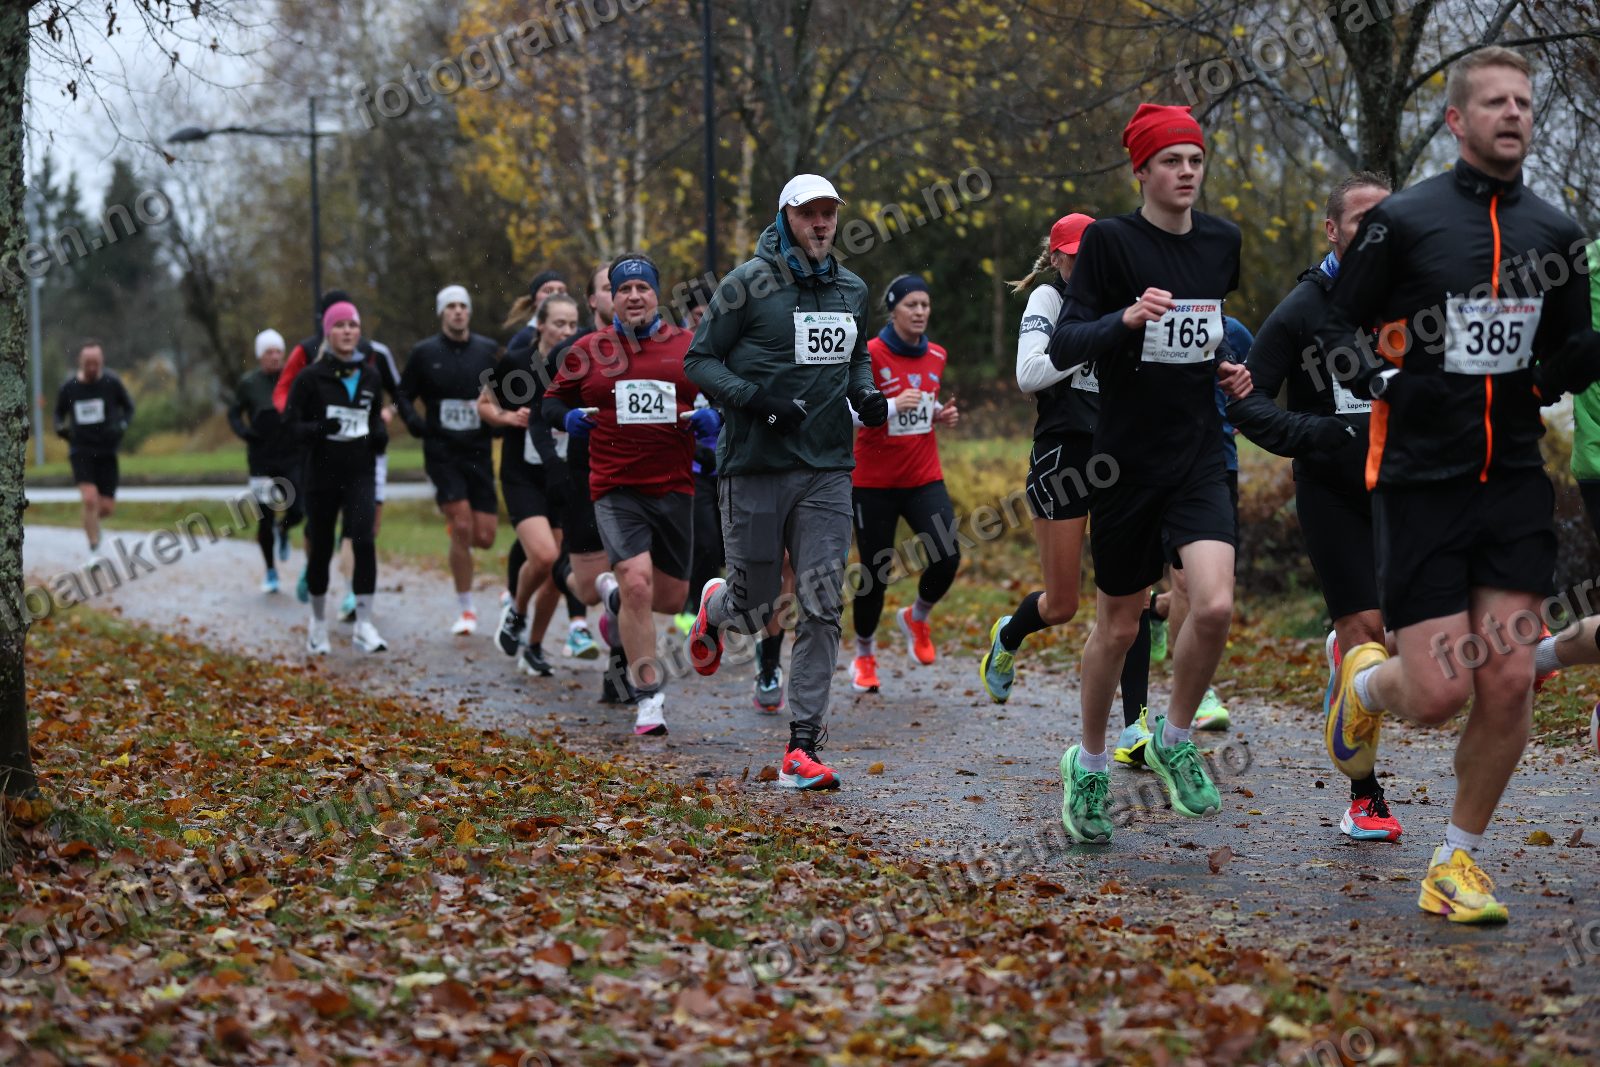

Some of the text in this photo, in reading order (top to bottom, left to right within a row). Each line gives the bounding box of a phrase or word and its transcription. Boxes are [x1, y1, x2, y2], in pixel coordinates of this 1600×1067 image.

[808, 327, 846, 354] 562
[1164, 317, 1209, 348] 165
[1466, 321, 1523, 356] 385
[628, 393, 665, 414] 824
[898, 405, 928, 427] 664
